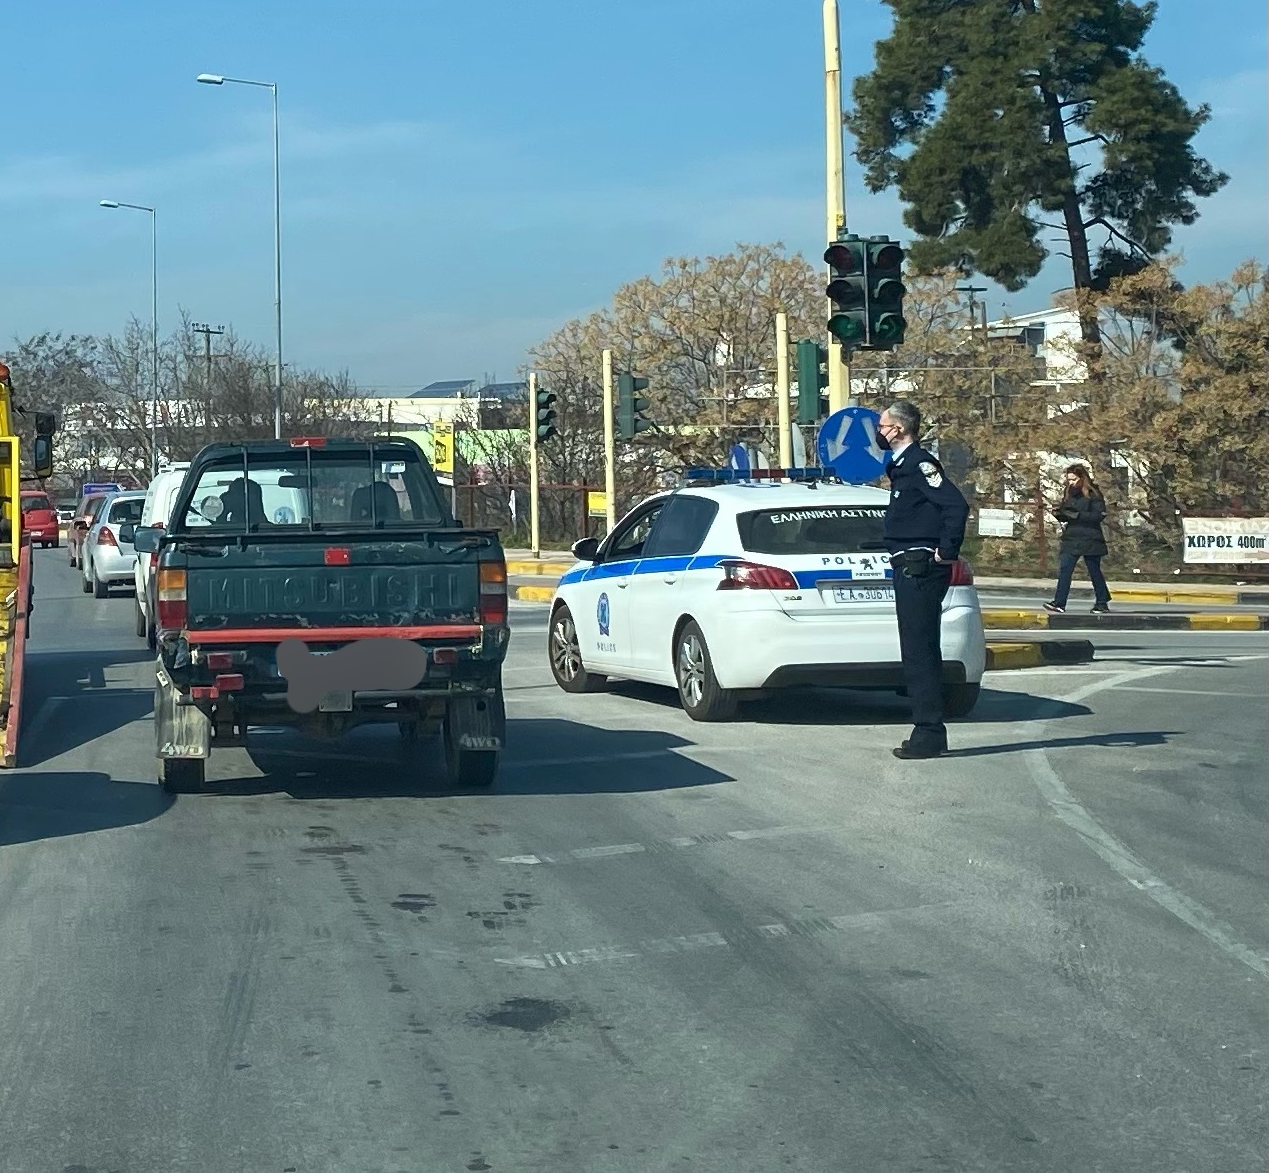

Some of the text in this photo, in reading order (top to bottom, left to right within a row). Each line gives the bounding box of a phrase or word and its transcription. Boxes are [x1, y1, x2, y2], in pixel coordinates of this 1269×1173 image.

[770, 510, 839, 524] ΕΛΛΗΝΙΚΗ
[1187, 535, 1233, 548] ΧΩΡΟΣ
[208, 573, 462, 610] MITSUBISHI
[460, 733, 500, 747] 4WD
[161, 742, 203, 756] 4WD
